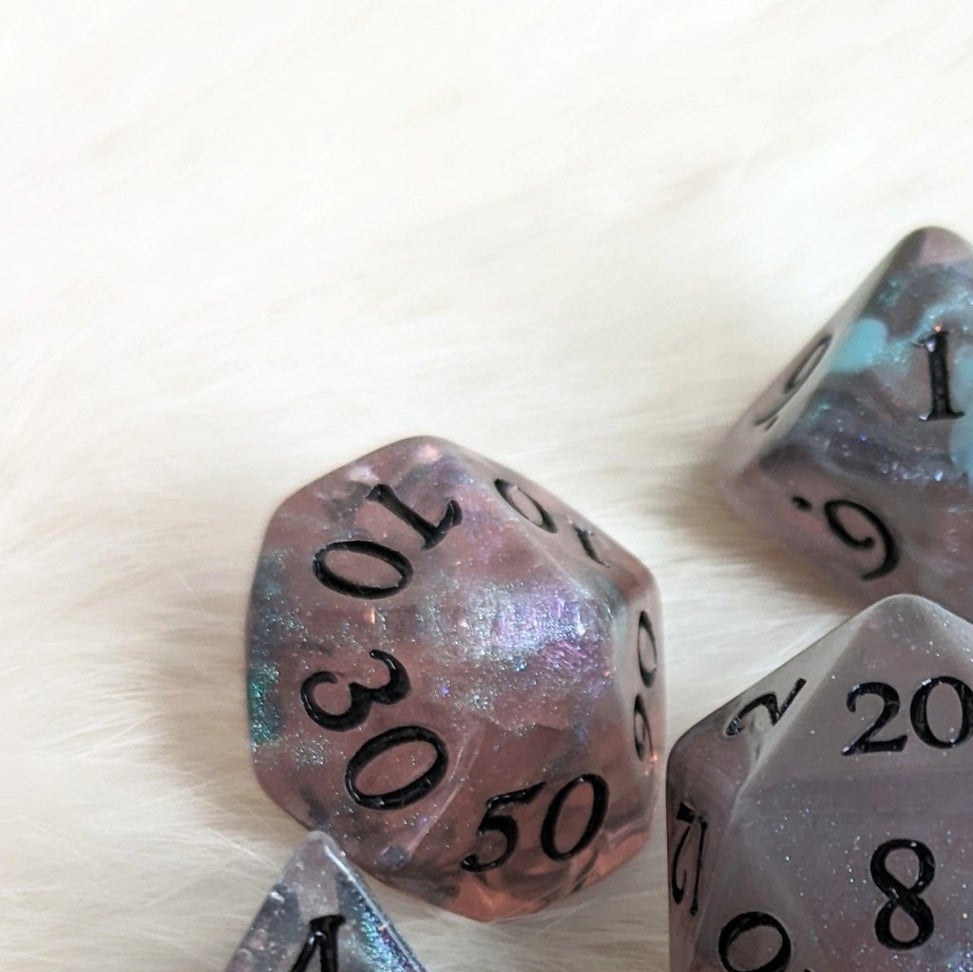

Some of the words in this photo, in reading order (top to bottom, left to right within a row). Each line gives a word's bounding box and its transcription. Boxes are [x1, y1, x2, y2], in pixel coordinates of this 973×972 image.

[917, 330, 965, 422] 1
[311, 482, 464, 601] 10
[300, 649, 449, 811] 30
[725, 677, 808, 738] 2
[460, 772, 611, 873] 50
[671, 801, 709, 918] 12
[869, 837, 937, 951] 8
